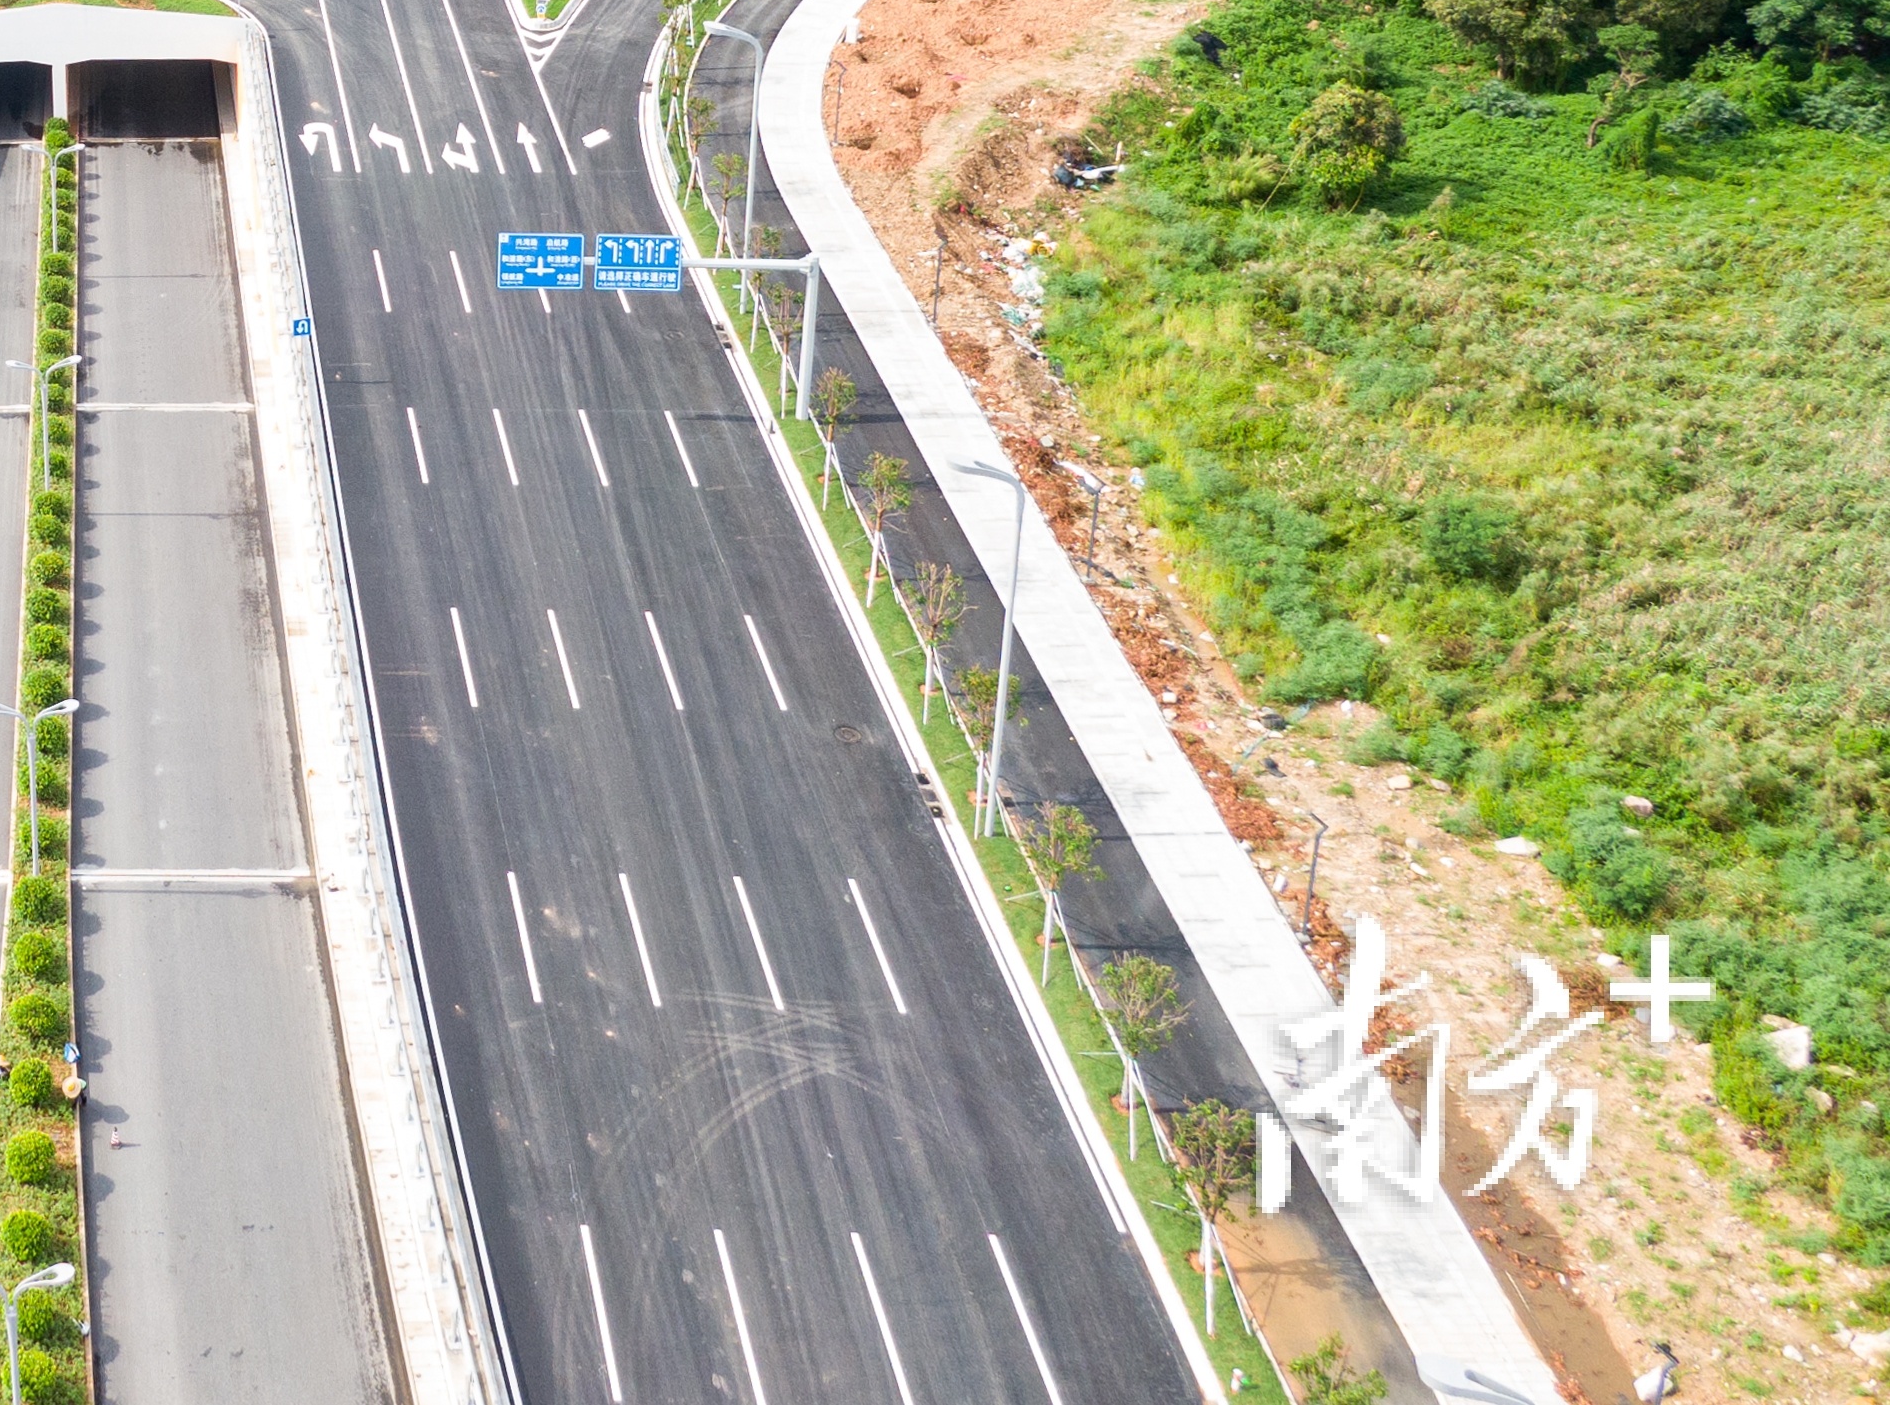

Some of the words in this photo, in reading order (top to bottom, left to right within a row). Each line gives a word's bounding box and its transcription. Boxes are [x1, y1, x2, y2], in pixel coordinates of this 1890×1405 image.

[598, 270, 676, 282] 请选择正确车道行驶
